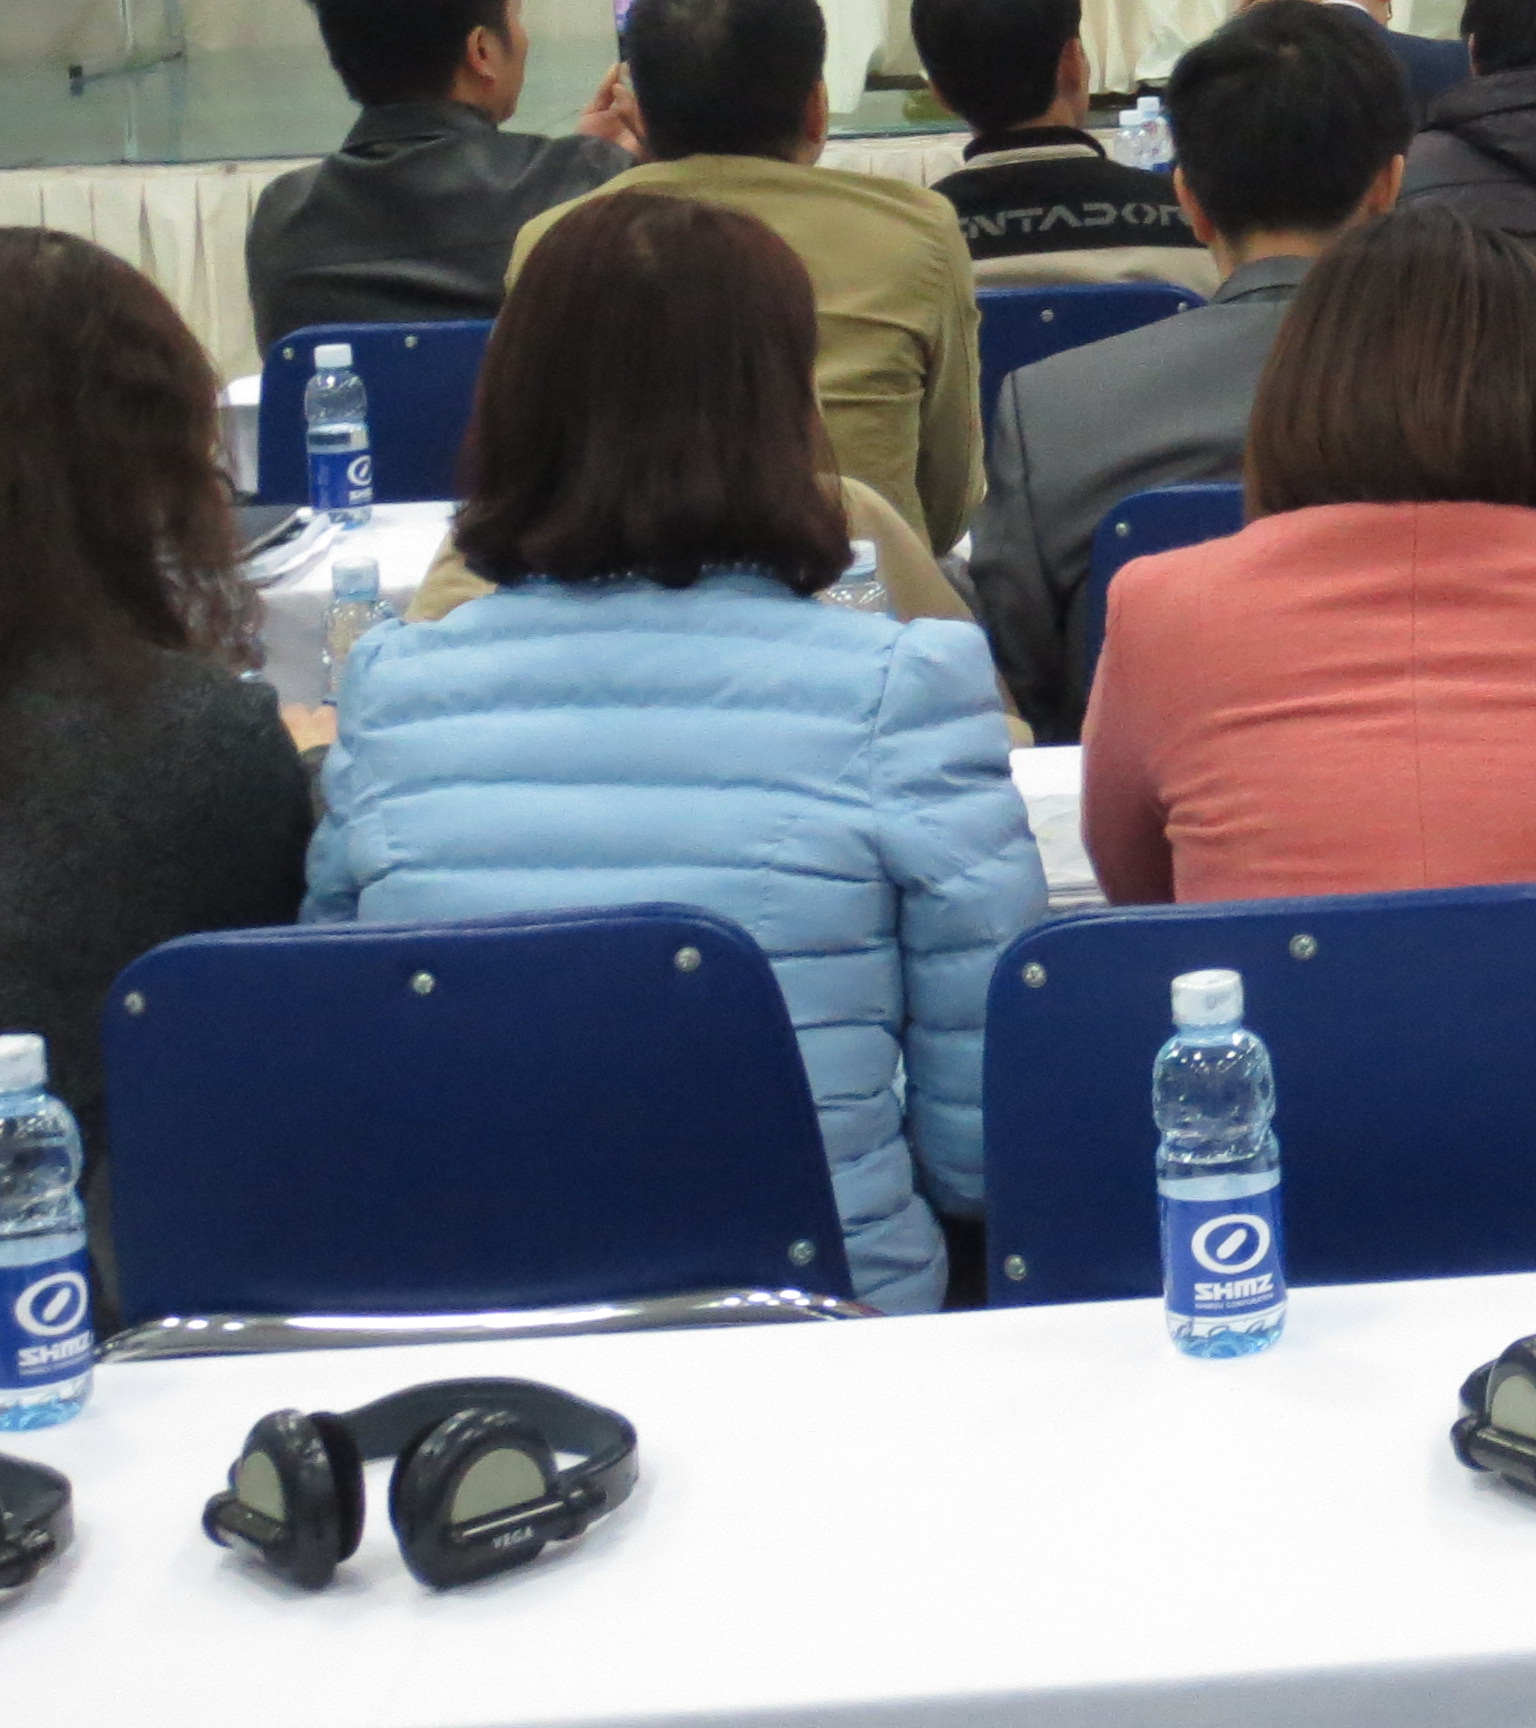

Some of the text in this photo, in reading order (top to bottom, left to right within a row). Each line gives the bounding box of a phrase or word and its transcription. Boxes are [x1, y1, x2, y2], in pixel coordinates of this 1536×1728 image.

[959, 201, 1192, 240] NTADOR
[1194, 1270, 1275, 1301] SHMZ
[491, 1524, 533, 1549] VEGA
